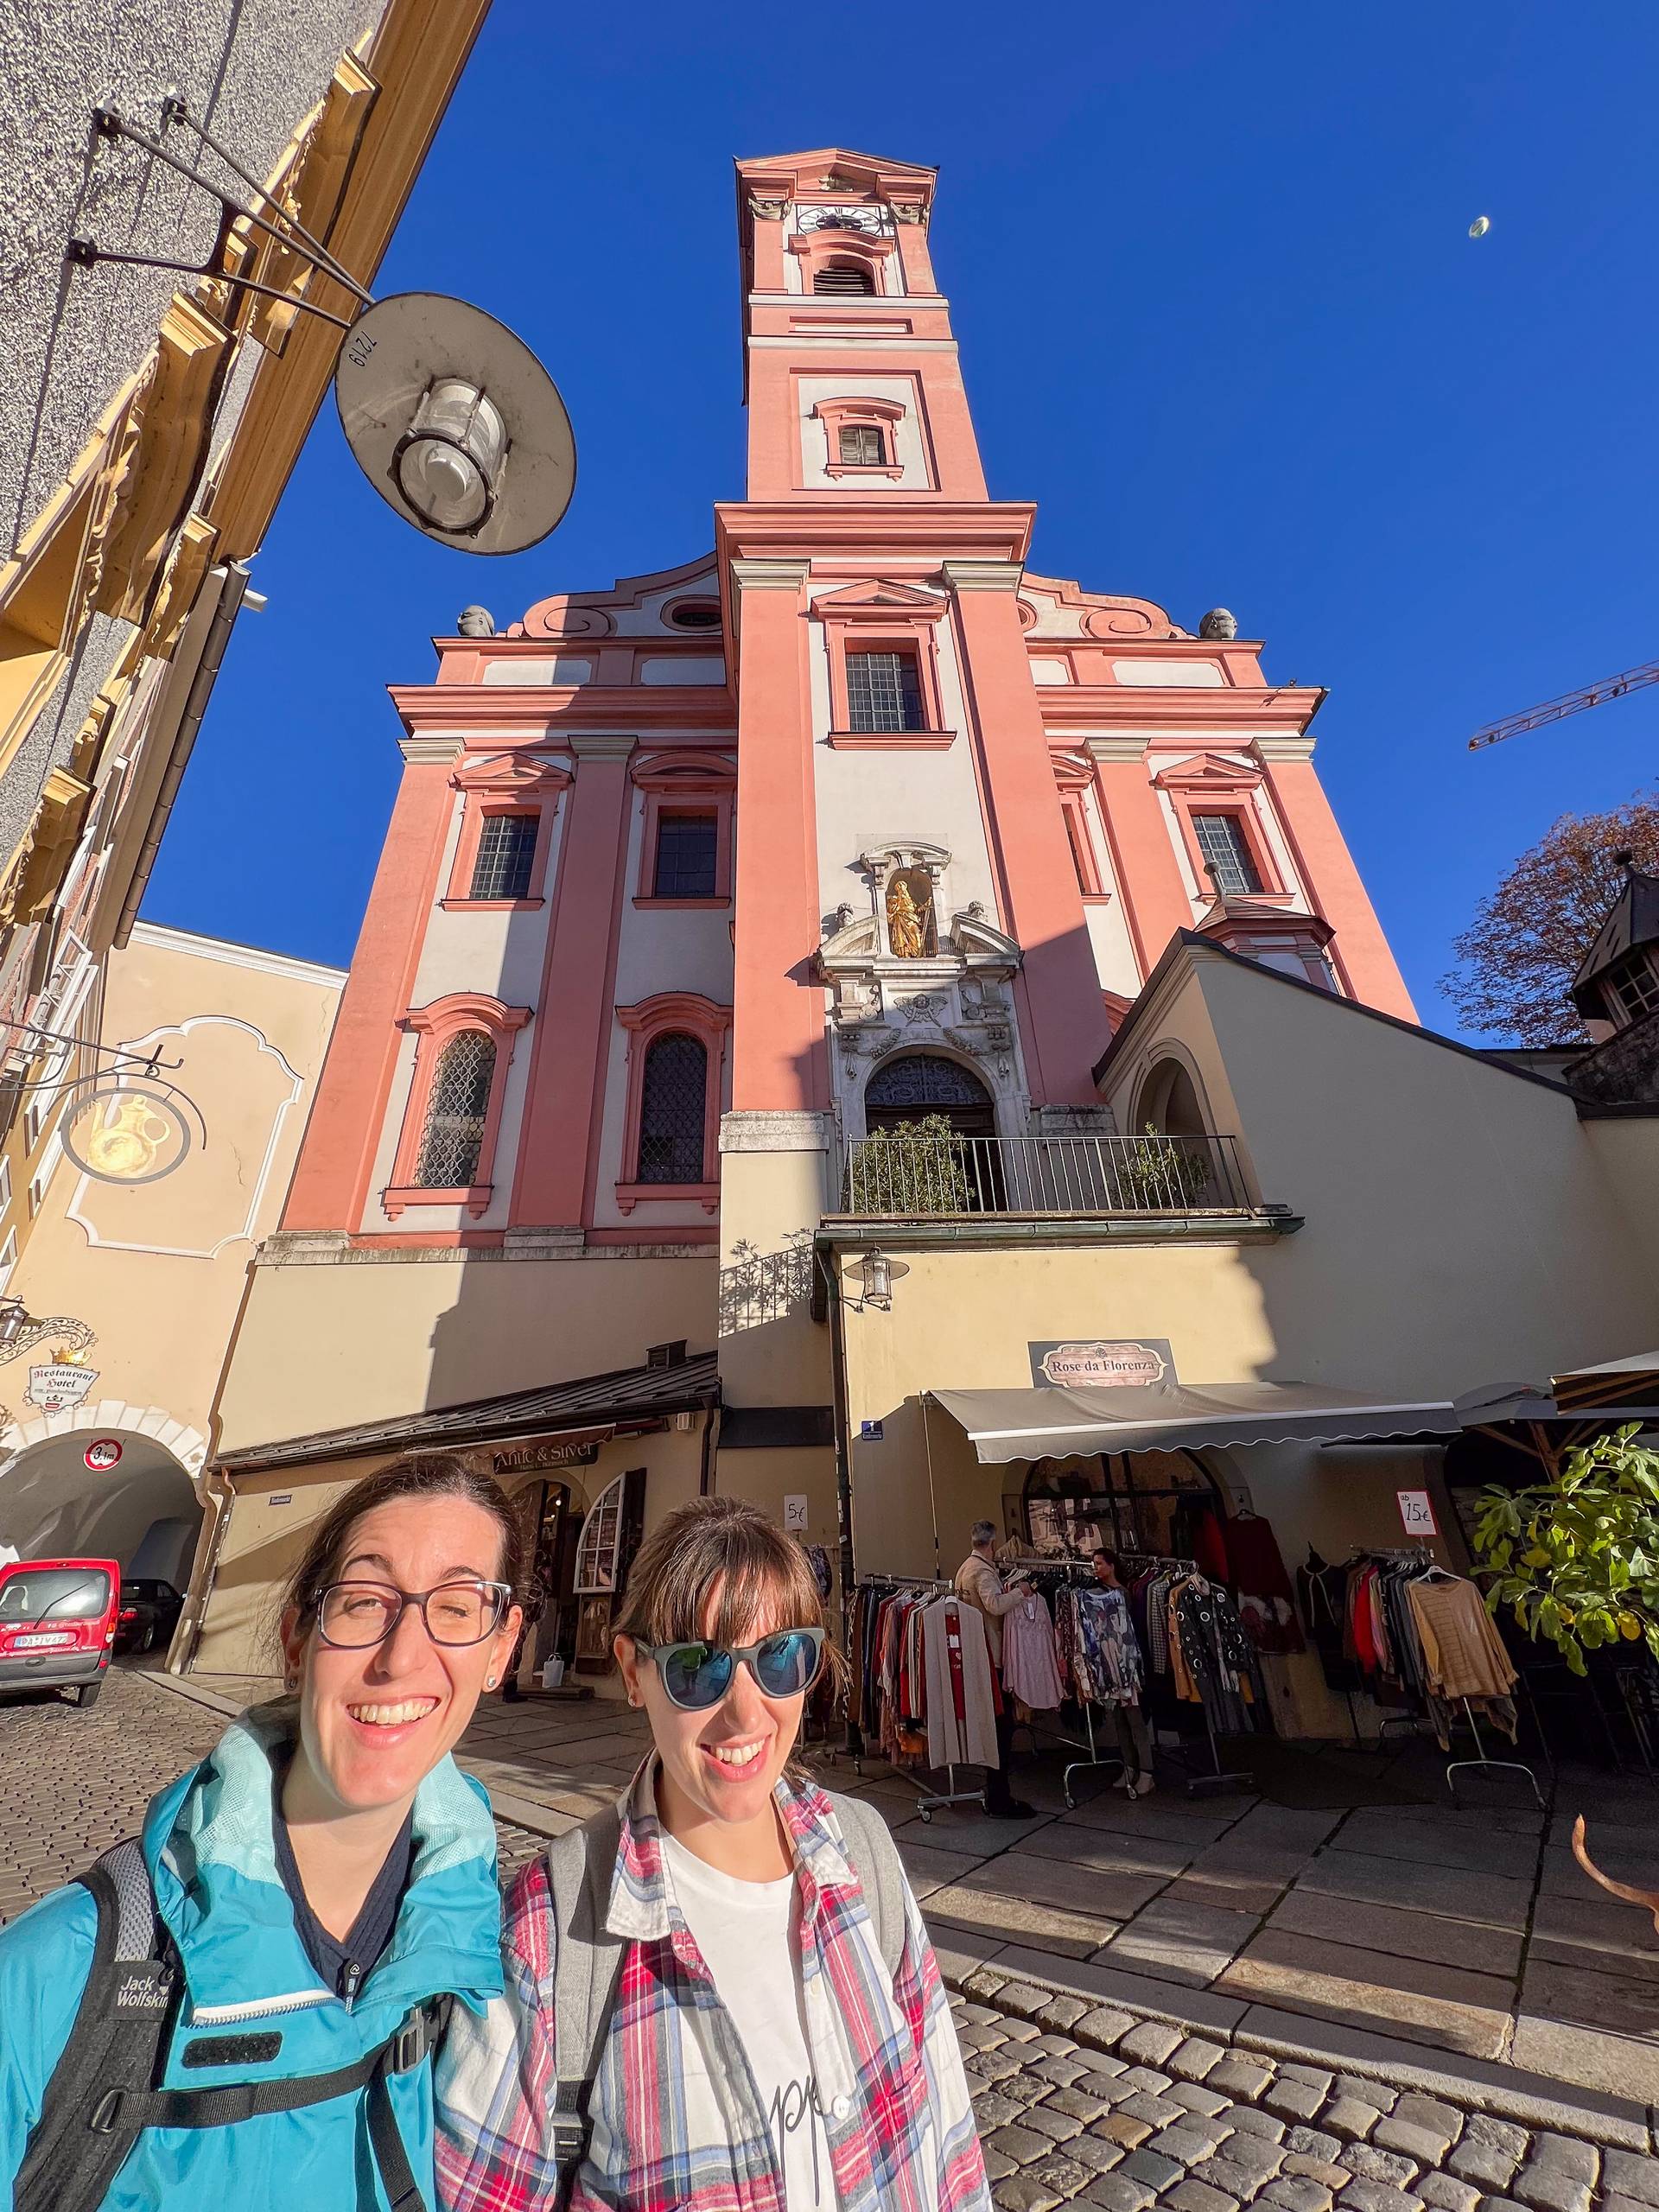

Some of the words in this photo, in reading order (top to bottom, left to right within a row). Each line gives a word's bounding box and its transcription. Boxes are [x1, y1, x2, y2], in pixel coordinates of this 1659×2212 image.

[348, 330, 378, 367] 7219
[1052, 1361, 1081, 1372] Rose
[1085, 1360, 1099, 1371] da
[1103, 1359, 1155, 1371] Florenza
[34, 1369, 93, 1382] Restaurant
[47, 1379, 76, 1388] Hotel
[121, 1975, 155, 1991] Jack
[118, 1991, 169, 2009] Wolfskin
